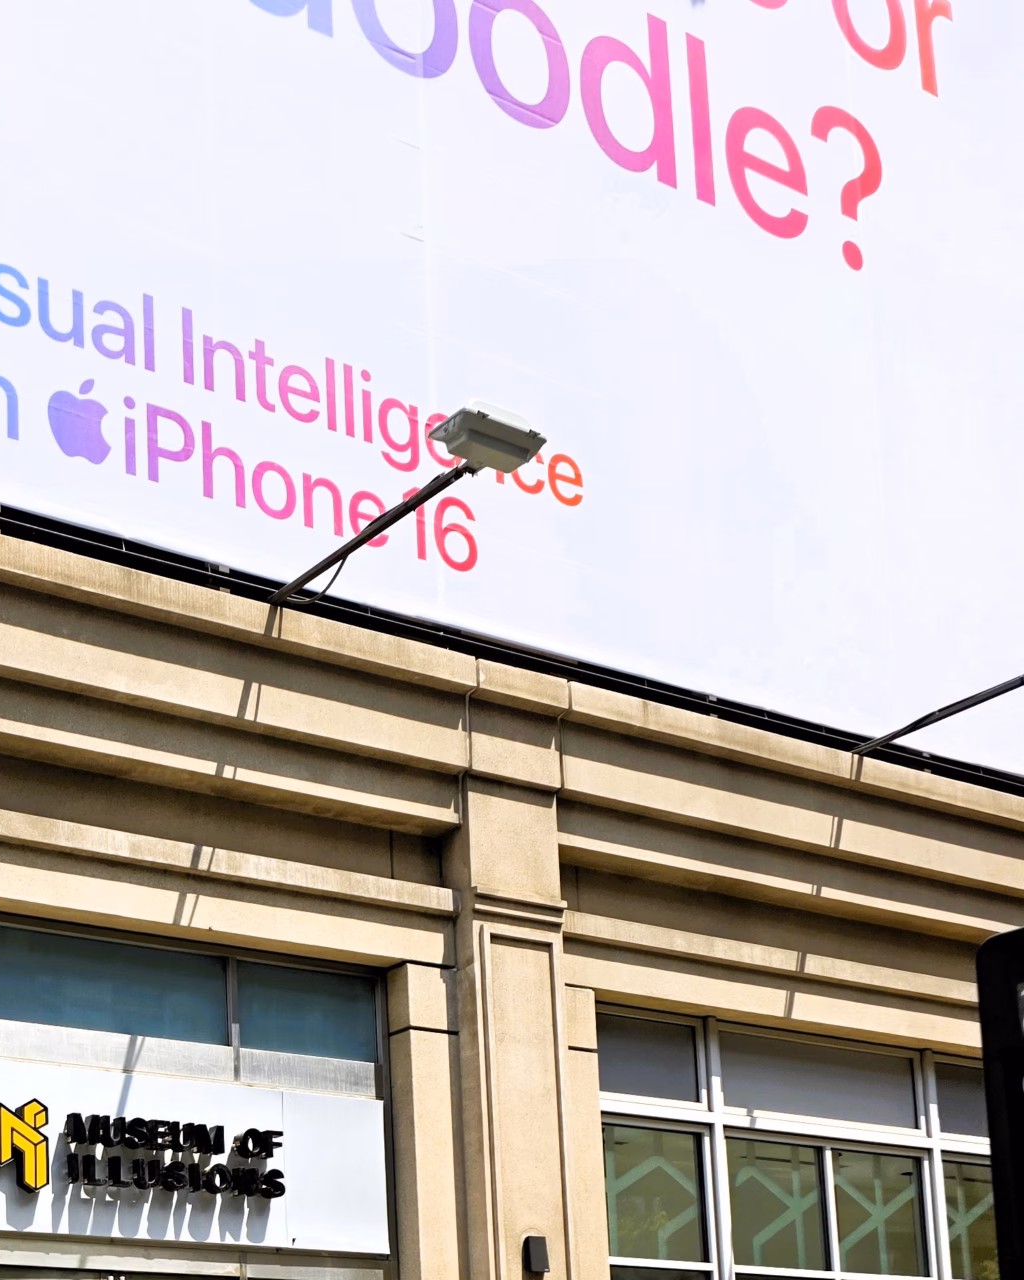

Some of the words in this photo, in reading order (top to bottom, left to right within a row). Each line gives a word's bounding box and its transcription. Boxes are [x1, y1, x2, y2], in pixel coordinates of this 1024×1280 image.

[182, 306, 584, 507] Intelligece
[123, 396, 390, 548] iPhone
[403, 487, 478, 572] 16
[66, 1113, 224, 1155] MUSEUM
[233, 1128, 284, 1160] OF
[67, 1153, 286, 1198] ILLUSIONS
